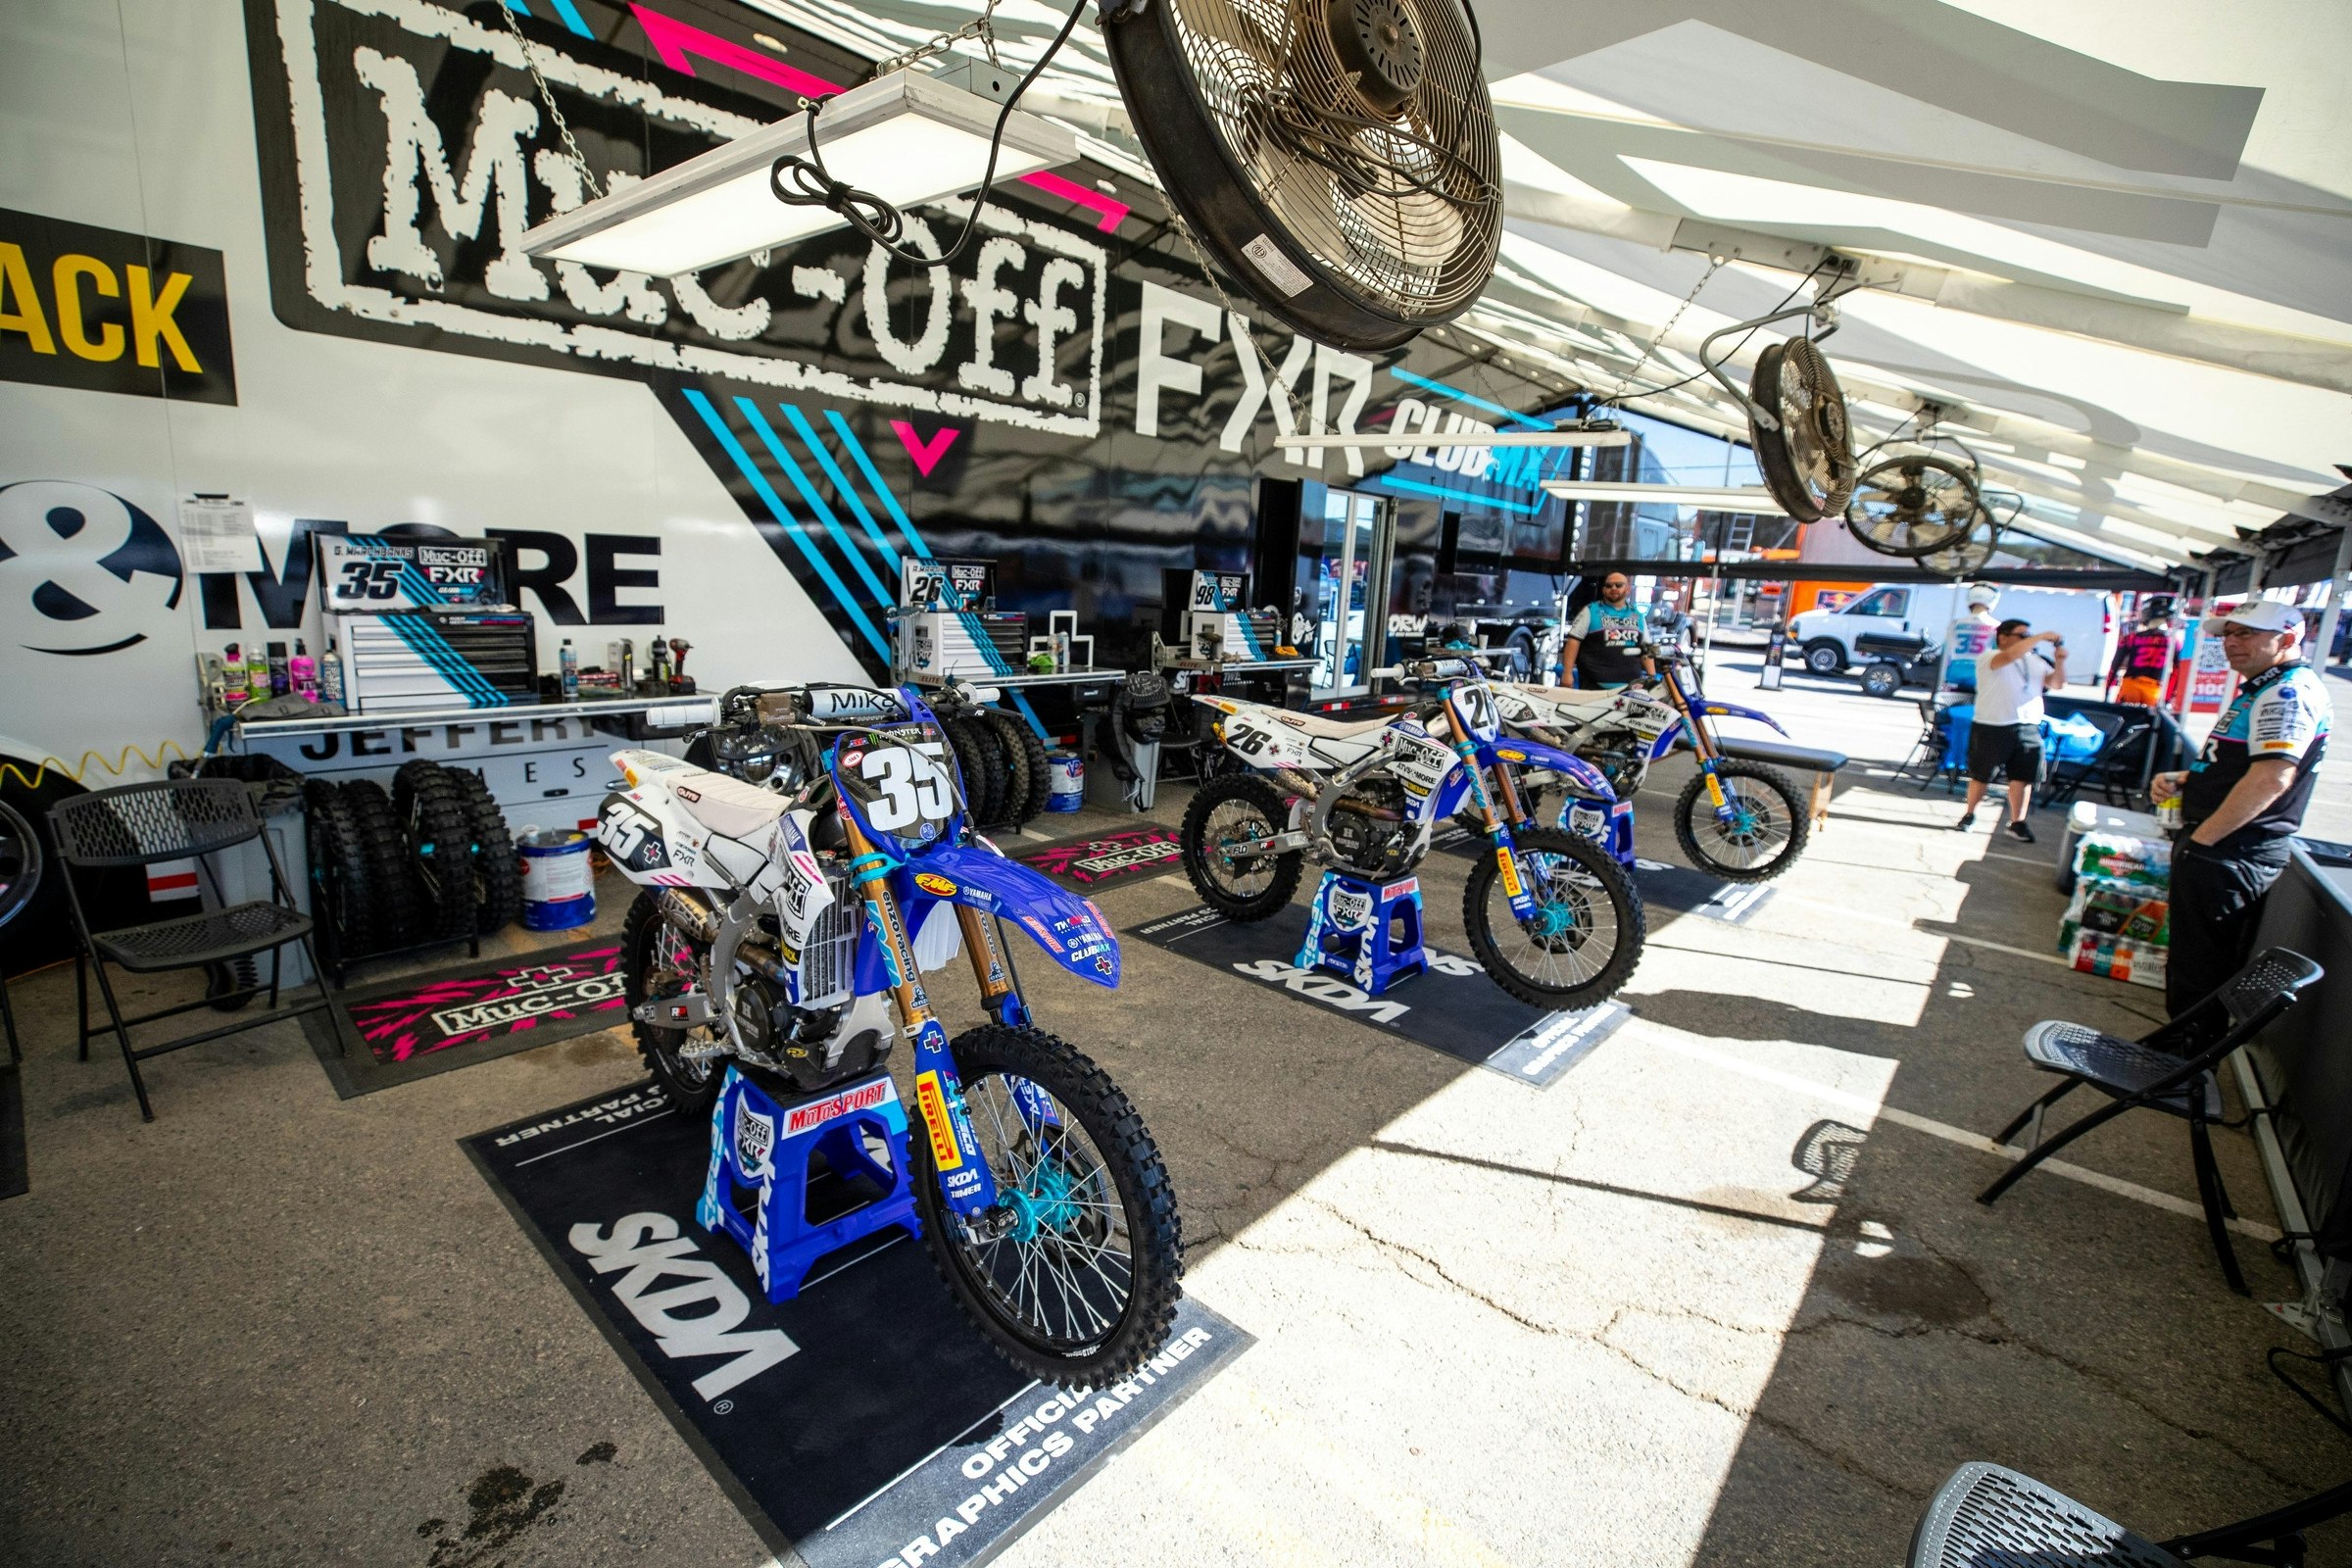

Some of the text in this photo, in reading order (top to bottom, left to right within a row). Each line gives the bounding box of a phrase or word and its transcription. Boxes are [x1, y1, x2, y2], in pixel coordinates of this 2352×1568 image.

[1135, 280, 1374, 477] FXR
[199, 519, 664, 629] MRE
[421, 548, 486, 564] Muc-Off
[429, 566, 481, 583] FXR
[336, 562, 405, 600] 35
[909, 575, 944, 602] 26
[955, 579, 980, 591] FXR
[1195, 585, 1216, 605] 98
[1955, 634, 1987, 654] 35
[1227, 723, 1273, 756] 26
[862, 742, 954, 831] 35
[598, 802, 659, 859] 35
[673, 849, 696, 867] FXR
[916, 875, 956, 895] FMF
[969, 888, 992, 902] YAMAHA
[882, 891, 901, 932] enzo
[895, 932, 916, 983] racing
[1071, 943, 1110, 962] CLUBMX
[448, 978, 628, 1028] Muc-Of
[1233, 959, 1411, 1024] SKDA
[495, 1093, 642, 1147] PARTNER
[919, 1081, 955, 1162] PIRELLI
[947, 1168, 978, 1188] SKDA
[568, 1211, 802, 1402] SKDA
[1072, 1327, 1213, 1435] PARTNER
[961, 1384, 1094, 1480] OFFICIA
